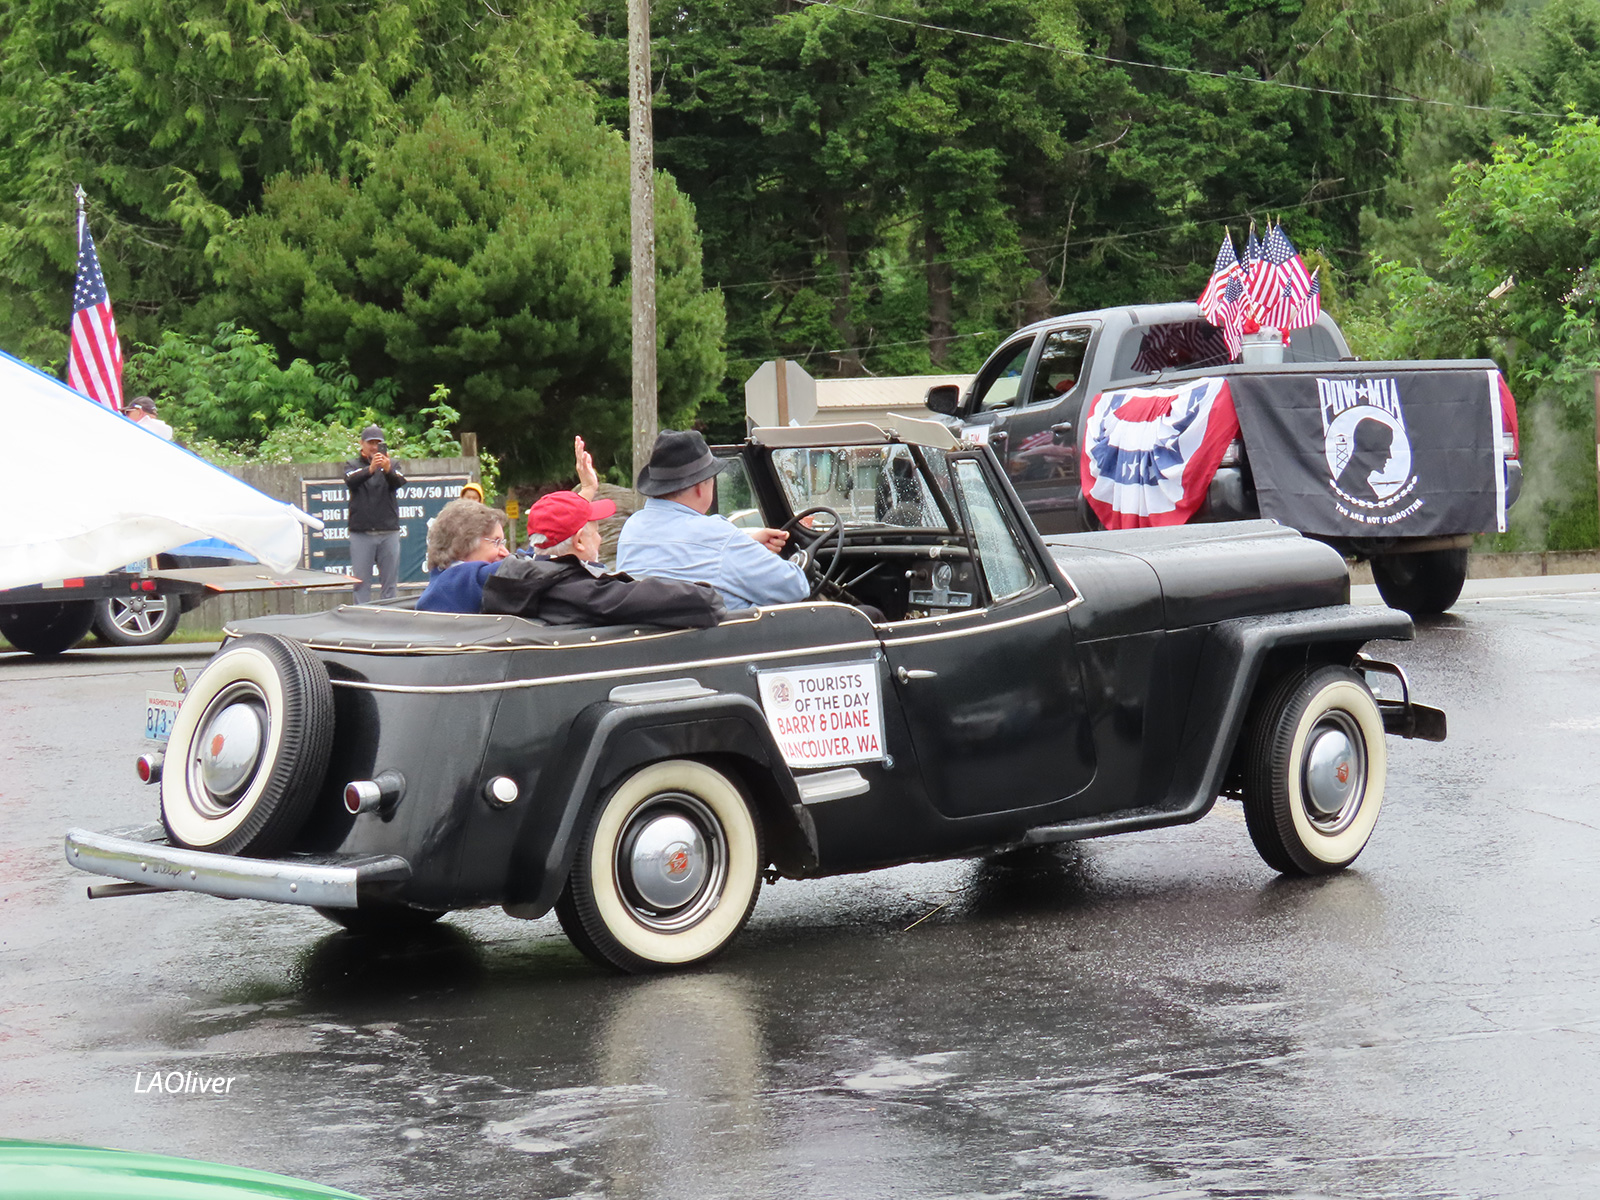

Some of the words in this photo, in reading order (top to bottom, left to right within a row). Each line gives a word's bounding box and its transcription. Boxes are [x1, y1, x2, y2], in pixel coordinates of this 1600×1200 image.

[1316, 378, 1357, 438] POW
[1366, 378, 1406, 432] MIA
[322, 490, 344, 502] FULL
[322, 509, 341, 521] BIG
[1335, 502, 1349, 516] YOU
[1349, 512, 1365, 522] ARE
[1366, 516, 1381, 524] NOT
[1382, 498, 1424, 524] FORGOTTEN
[323, 527, 350, 540] SELEC
[799, 674, 862, 693] TOURISTS
[149, 698, 177, 707] WASHINGTON
[794, 698, 811, 712] OF
[814, 695, 840, 710] THE
[843, 692, 870, 708] DAY
[777, 714, 816, 735] BARRY
[819, 713, 827, 732] &
[830, 709, 870, 731] DIANE
[780, 737, 855, 760] VANCOUVER,
[856, 734, 879, 753] WA
